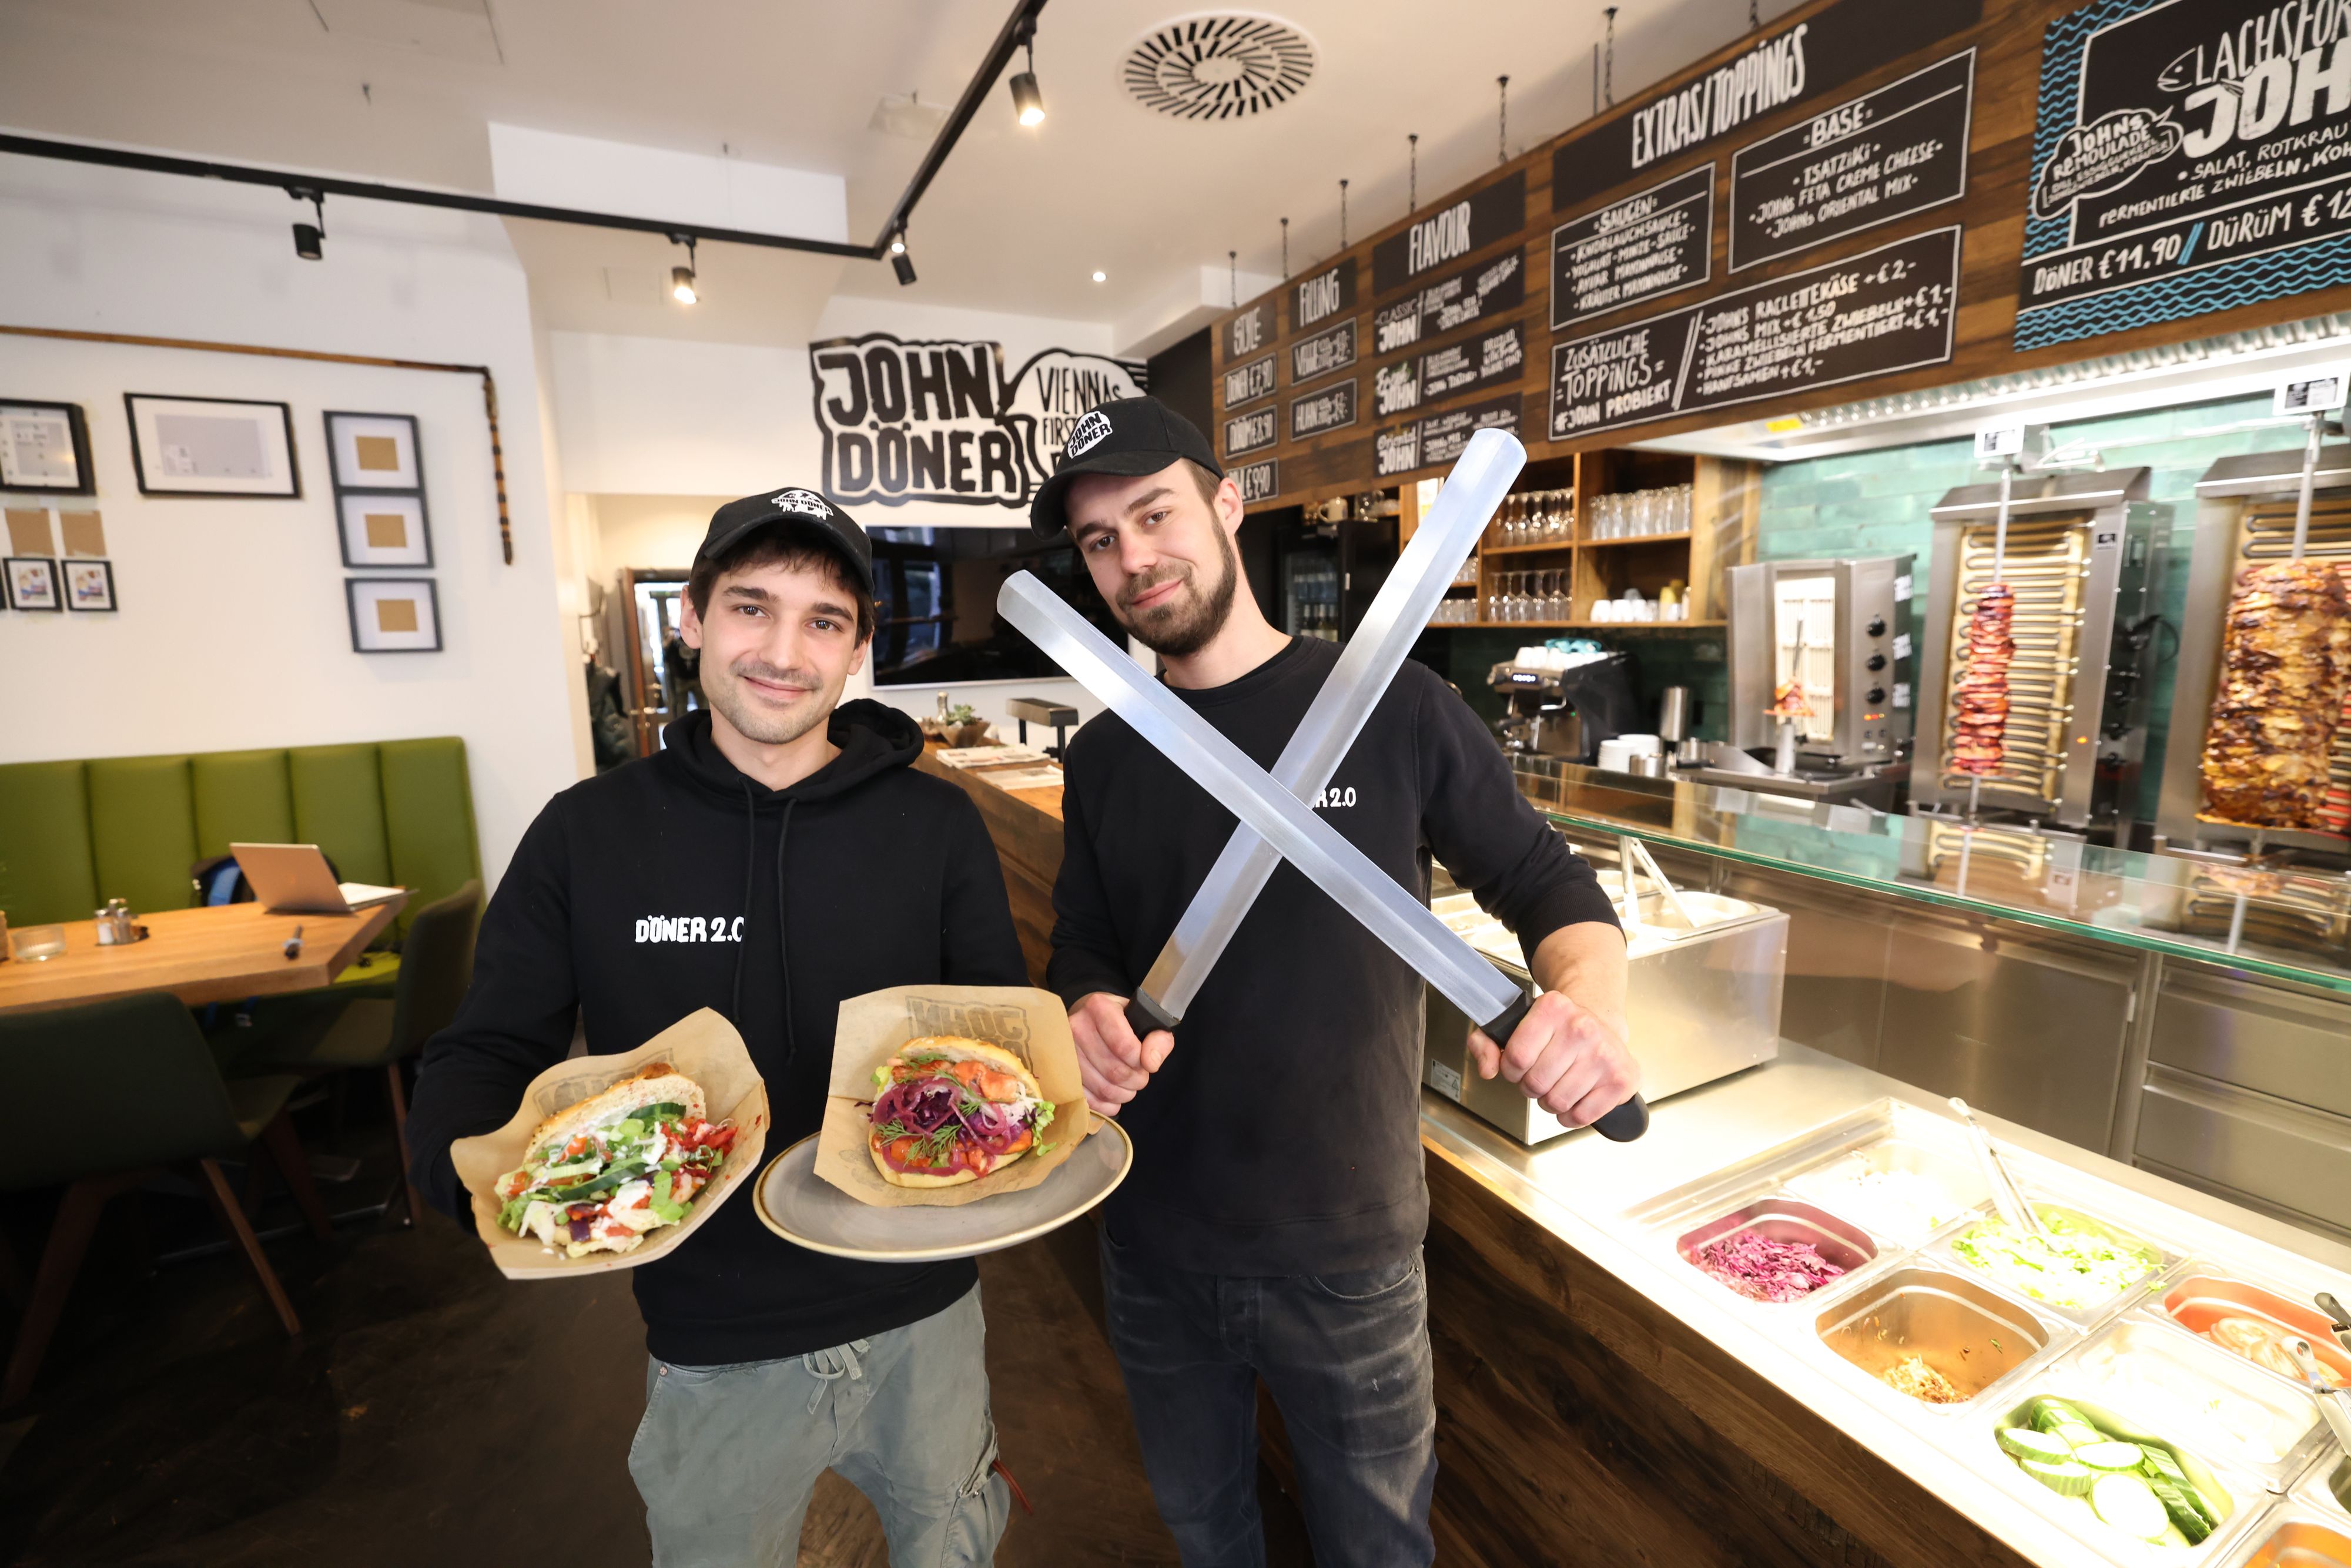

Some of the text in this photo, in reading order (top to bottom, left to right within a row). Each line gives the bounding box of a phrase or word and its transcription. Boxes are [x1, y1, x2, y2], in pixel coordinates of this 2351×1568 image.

[1810, 101, 1866, 147] BASE
[2067, 115, 2144, 158] JOHNS
[2257, 121, 2351, 162] ROTKRAU
[1408, 200, 1471, 275] FLAVOUR
[2033, 255, 2094, 295] DÖNER
[2208, 202, 2292, 251] DÜRÜM
[1378, 314, 1417, 353] JOHN
[819, 343, 997, 427] JOHN
[1605, 378, 1672, 419] PROBIERT
[1070, 413, 1102, 449] JOHN
[838, 420, 1017, 494] DÖNER
[1378, 443, 1416, 475] JOHN
[1329, 786, 1357, 808] 2.0
[635, 914, 707, 943] DÖNER
